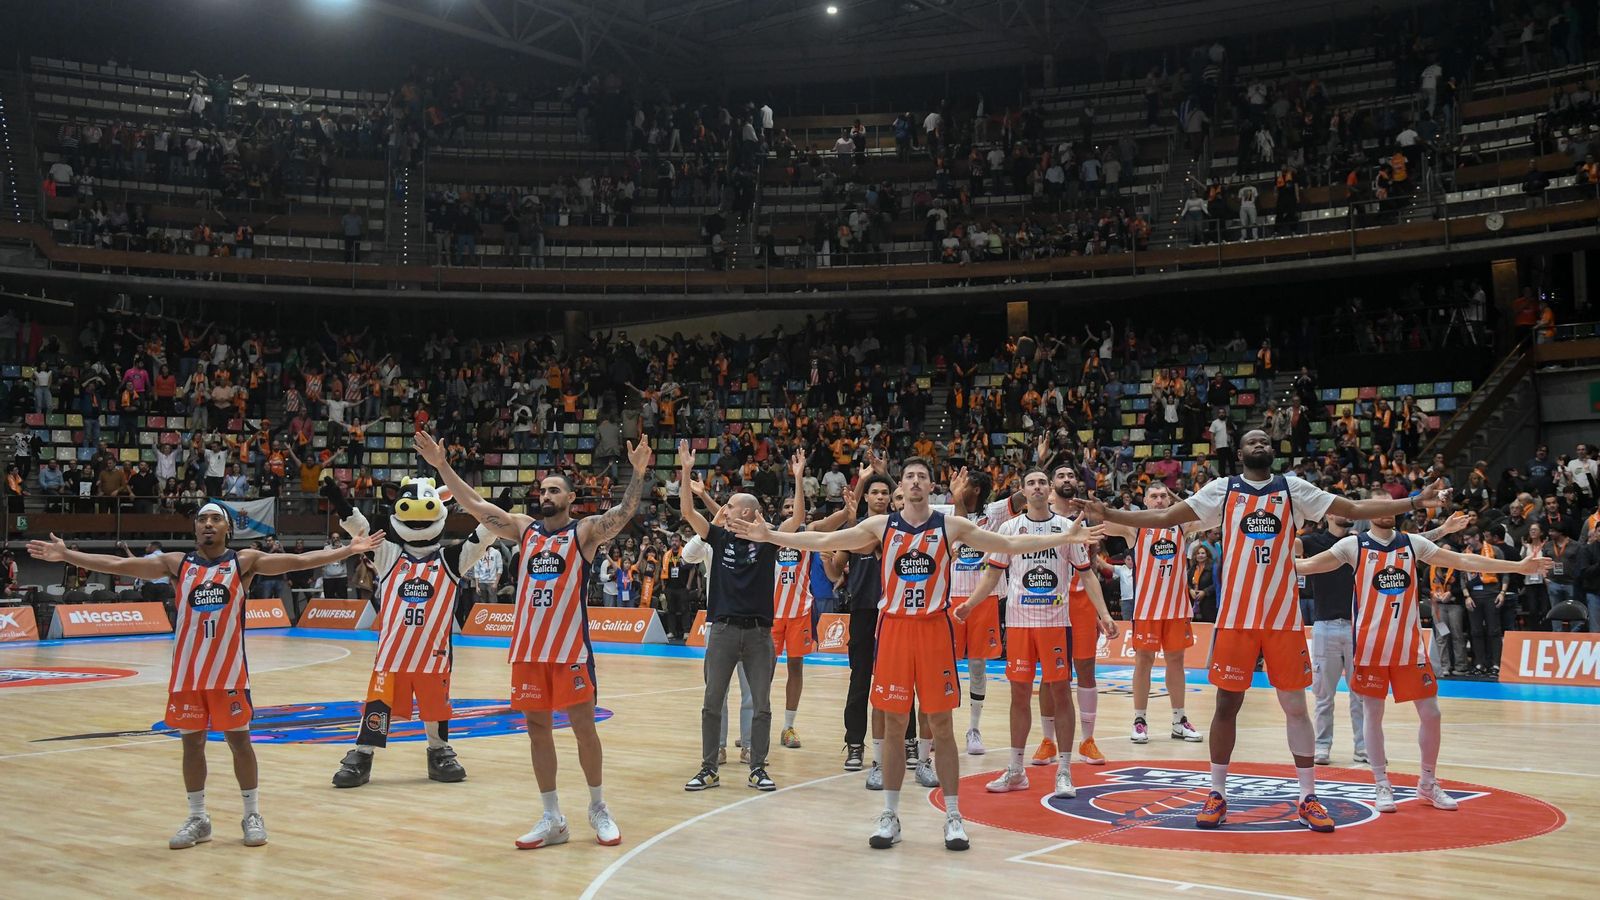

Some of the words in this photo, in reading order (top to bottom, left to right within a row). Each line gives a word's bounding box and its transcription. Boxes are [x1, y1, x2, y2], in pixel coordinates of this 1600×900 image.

[1246, 517, 1276, 525] Estrella
[1247, 525, 1276, 533] Galicia
[1255, 546, 1270, 565] 12
[533, 557, 560, 565] Estrella
[900, 557, 930, 566] Estrella
[533, 564, 558, 573] Galicia
[901, 565, 929, 575] Galicia
[1159, 564, 1173, 577] 77
[781, 571, 797, 585] 24
[1028, 573, 1053, 581] Estrella
[1378, 573, 1405, 581] Estrella
[404, 583, 430, 591] Estrella
[1380, 581, 1405, 589] Galicia
[194, 588, 225, 597] Estrella
[195, 596, 223, 605] Galicia
[533, 588, 554, 609] 23
[904, 588, 926, 609] 22
[1023, 596, 1051, 604] Aluman
[246, 608, 272, 620] alicia
[315, 609, 357, 619] UNIFERSA
[1390, 602, 1401, 619] 7
[404, 608, 425, 627] 96
[489, 613, 514, 622] PROS
[203, 619, 217, 639] 11
[601, 619, 633, 631] Galicia
